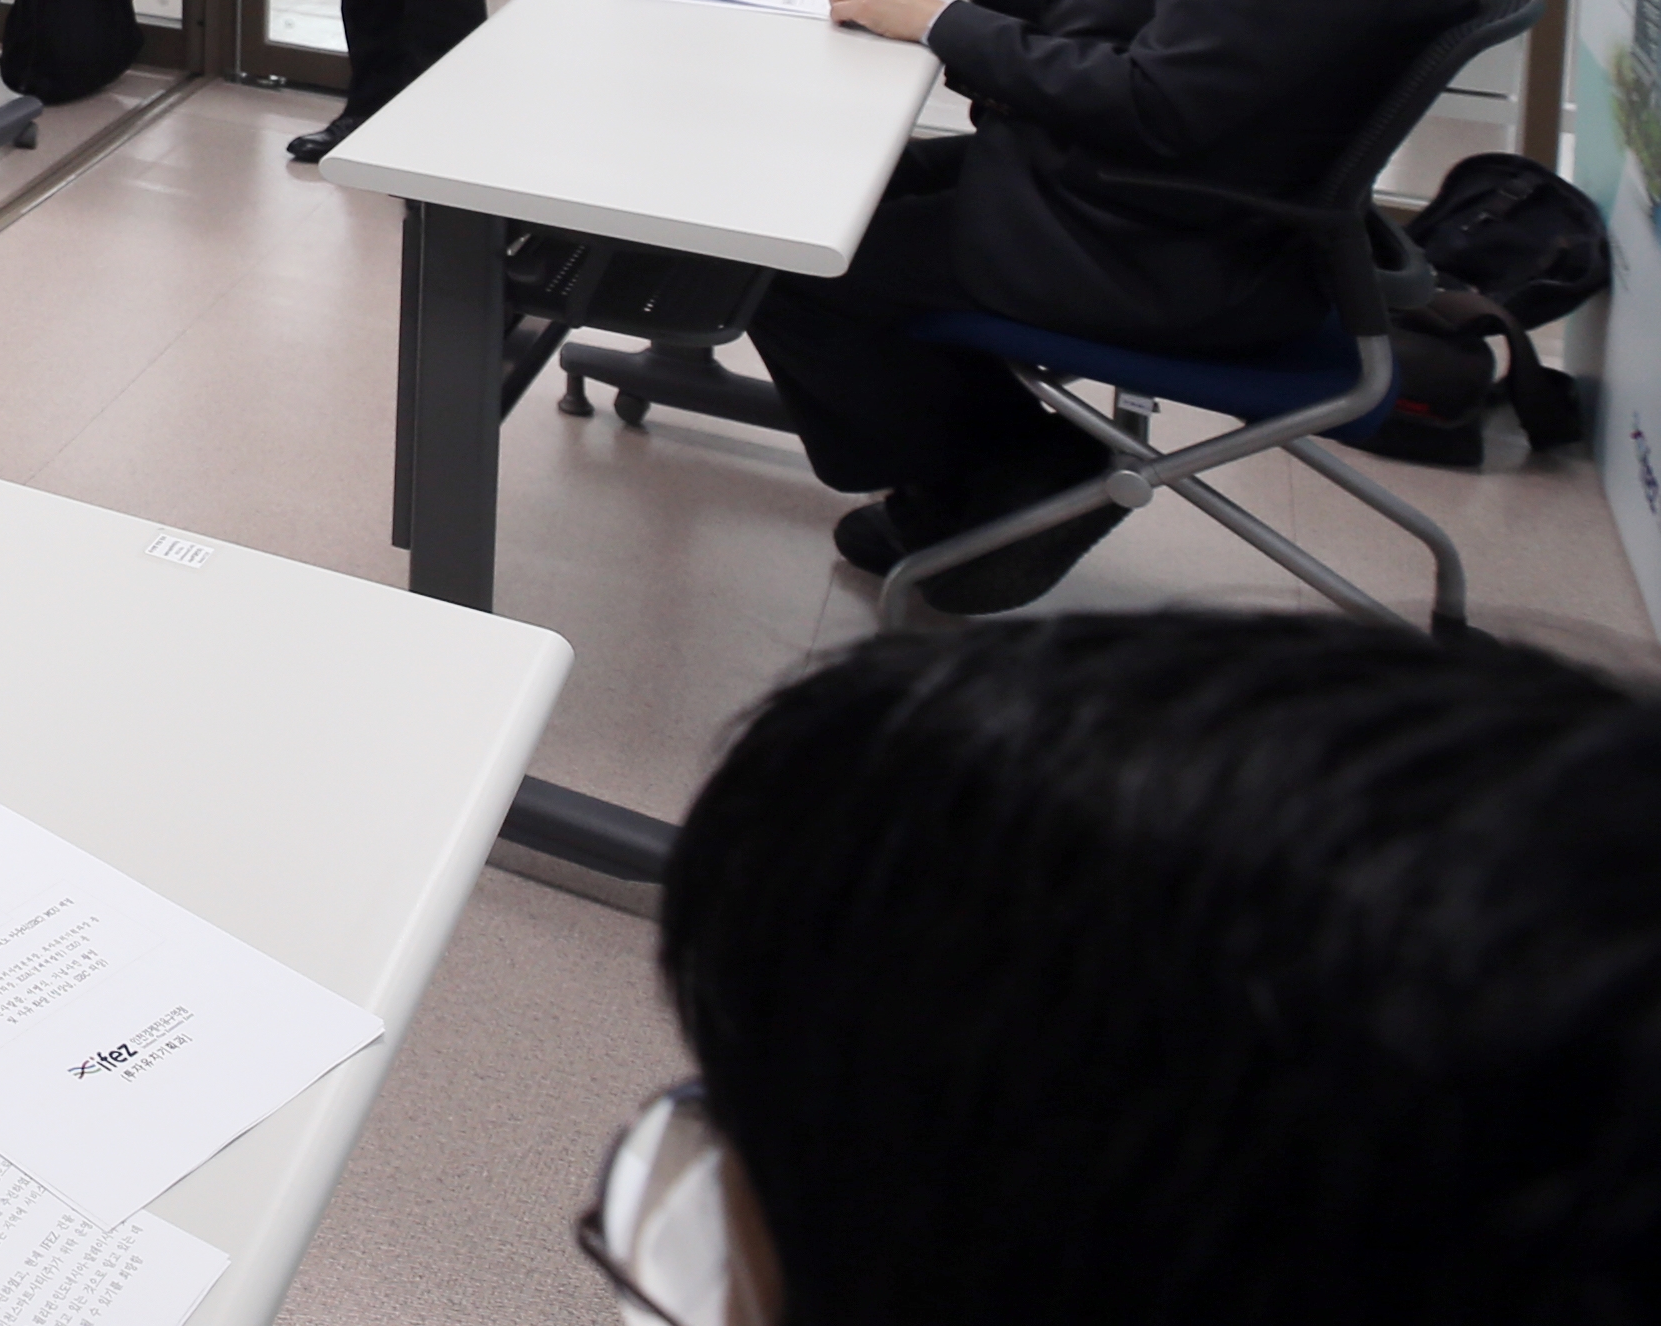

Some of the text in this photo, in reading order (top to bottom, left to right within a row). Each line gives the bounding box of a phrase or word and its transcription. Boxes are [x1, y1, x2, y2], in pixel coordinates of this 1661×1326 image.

[89, 1043, 139, 1071] ifez
[39, 1230, 60, 1251] IFEZ
[82, 1269, 107, 1294] 것으로
